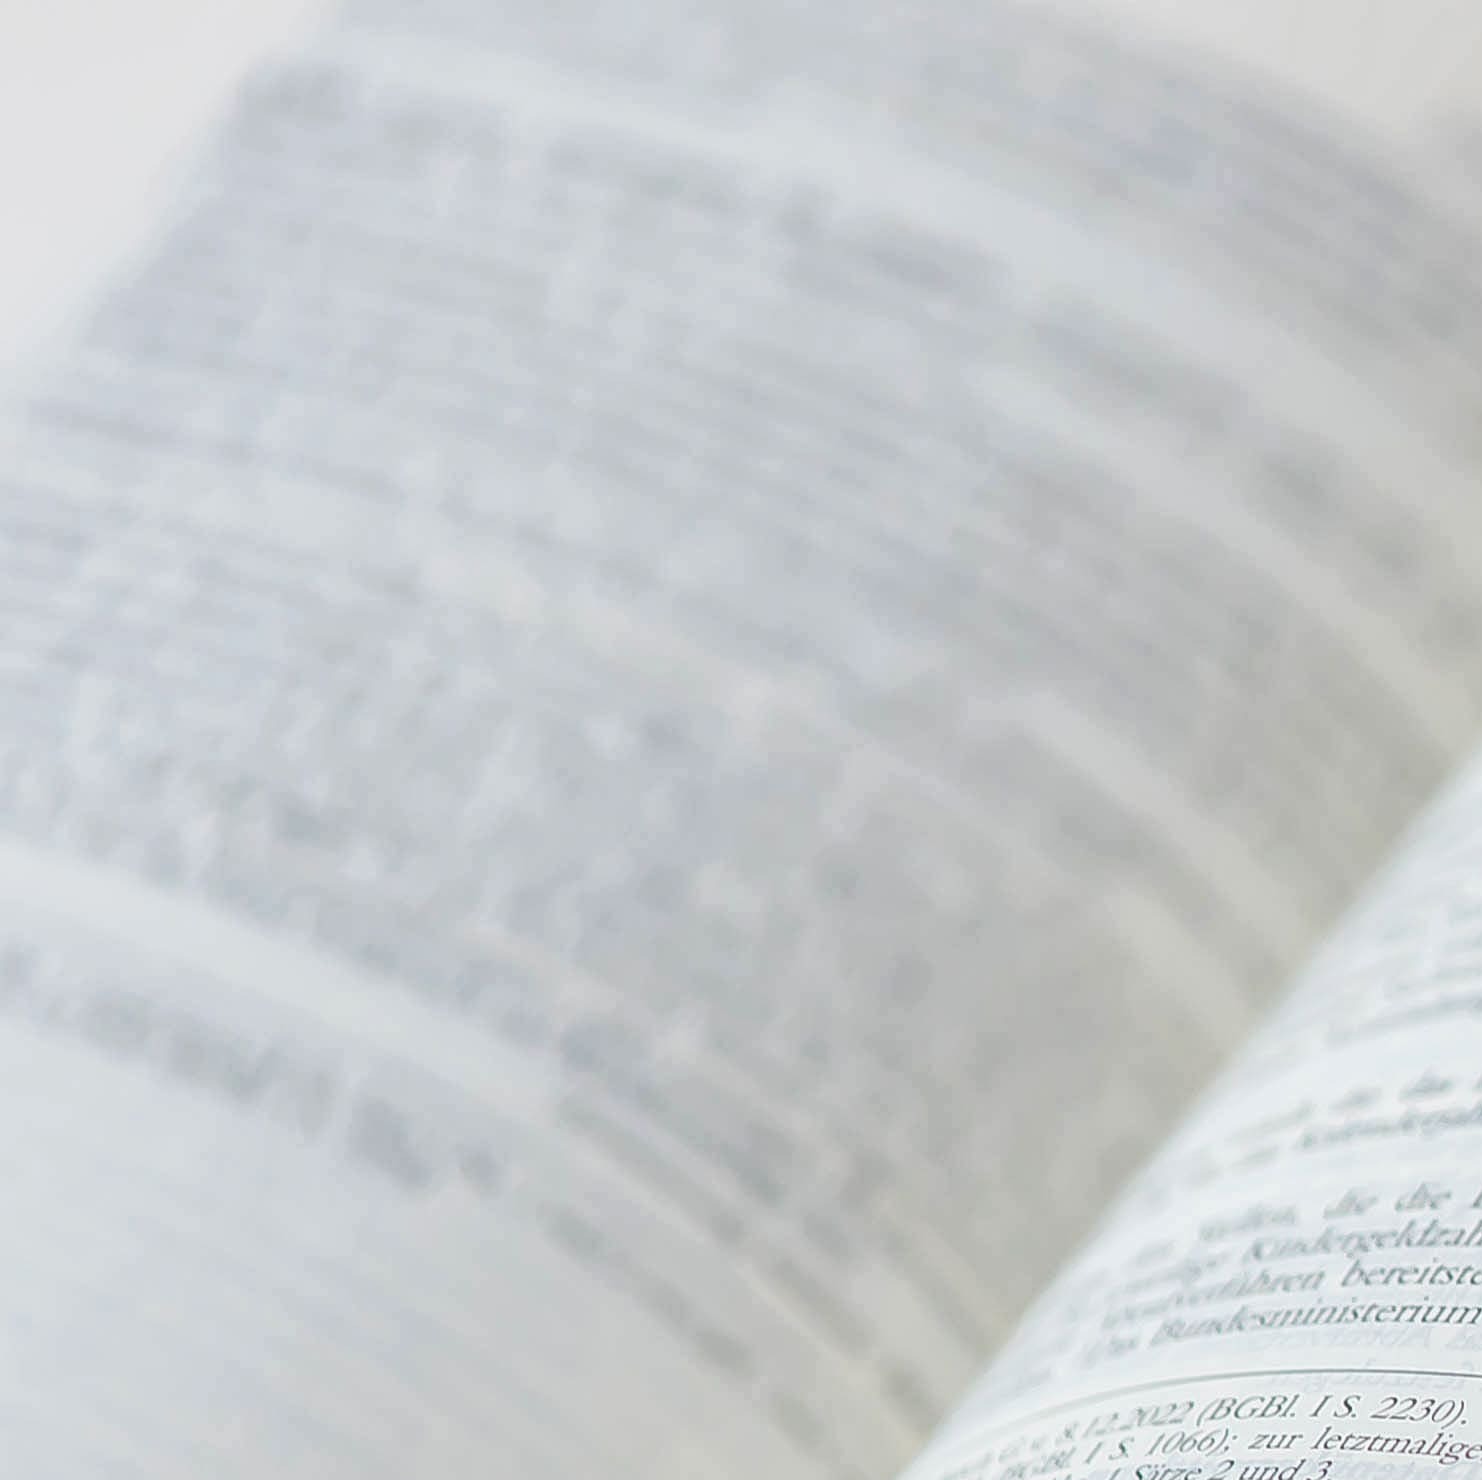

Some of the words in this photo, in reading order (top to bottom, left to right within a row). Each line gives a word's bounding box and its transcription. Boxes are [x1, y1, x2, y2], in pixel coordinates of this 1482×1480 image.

[1149, 1297, 1482, 1347] Bundesministerium
[1197, 1395, 1298, 1427] (BGBl.
[1332, 1395, 1359, 1419] S.
[1370, 1396, 1469, 1427] 2230).
[1145, 1430, 1236, 1460] 1066);
[1248, 1431, 1303, 1452] zur
